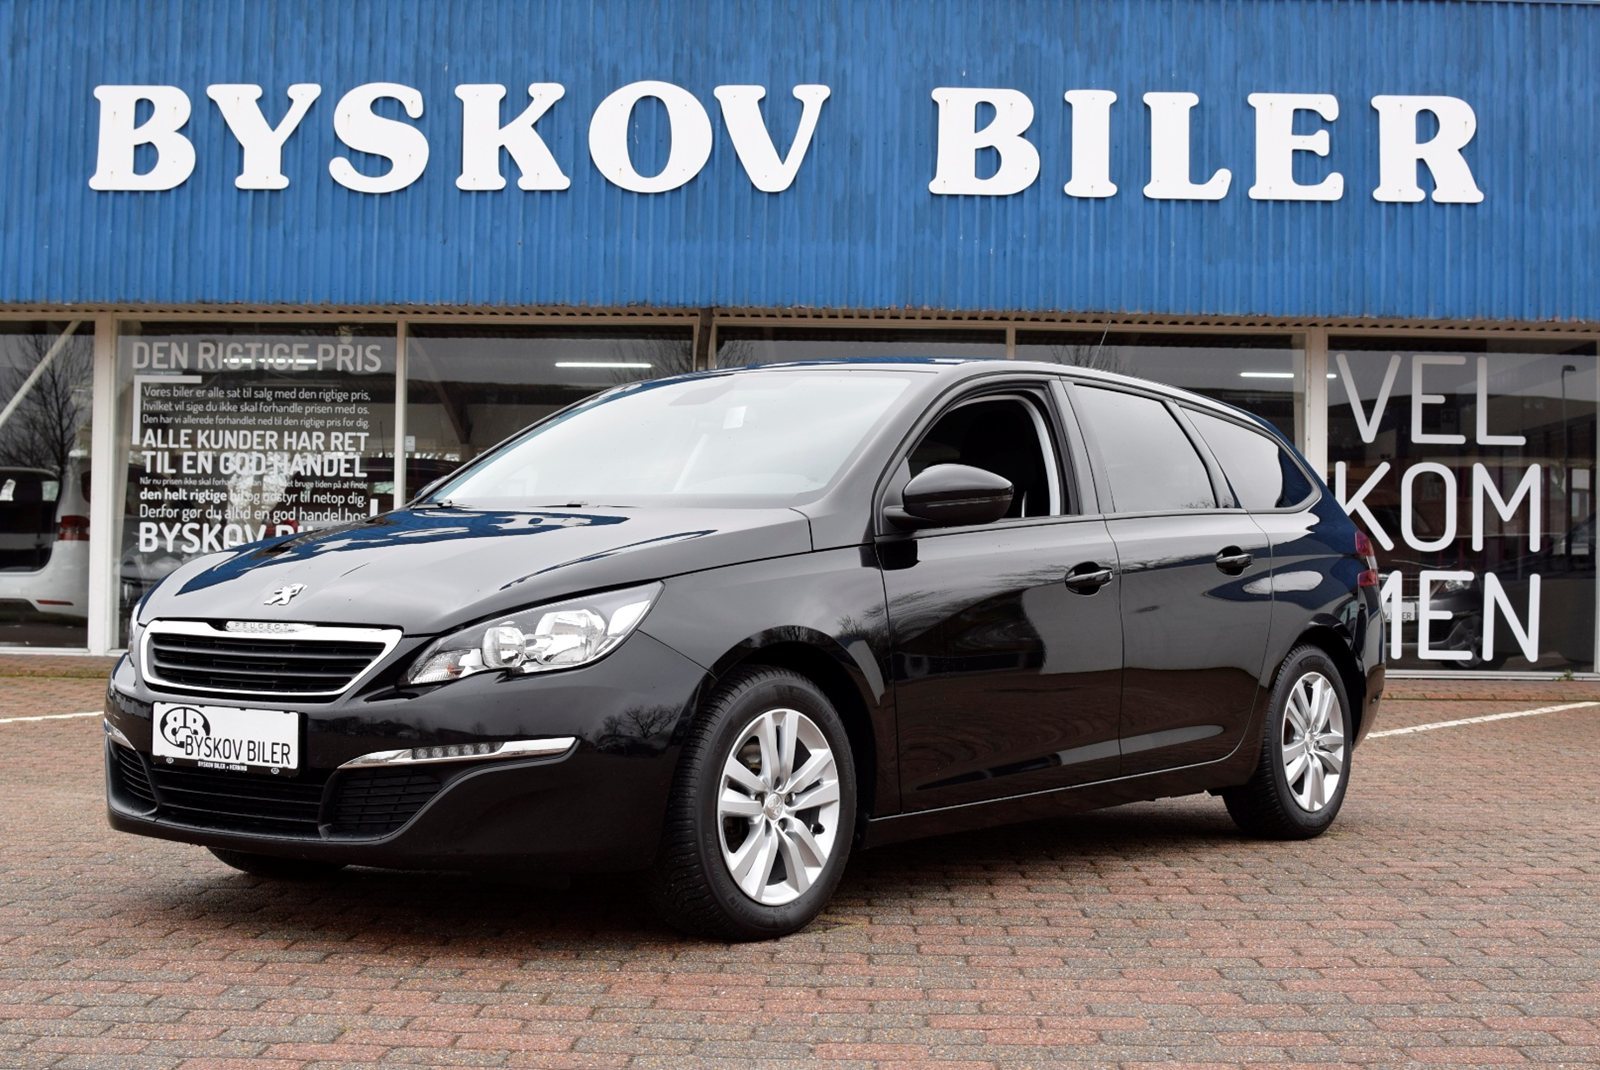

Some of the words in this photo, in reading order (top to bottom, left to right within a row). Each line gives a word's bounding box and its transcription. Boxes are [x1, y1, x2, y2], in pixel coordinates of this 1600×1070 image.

[88, 80, 832, 195] BYSKOV
[928, 86, 1485, 205] BILER
[132, 341, 188, 370] DEN
[197, 341, 310, 371] RIGTIGE
[317, 343, 382, 373] PRIS
[143, 386, 171, 397] Vores
[173, 386, 194, 397] biler
[195, 389, 205, 397] er
[207, 387, 225, 398] alle
[226, 388, 241, 398] sat
[243, 387, 252, 398] til
[253, 387, 273, 401] salg
[274, 388, 296, 399] med
[298, 388, 317, 399] den
[318, 389, 349, 402] rigtige
[350, 389, 371, 402] pris,
[1335, 353, 1527, 446] VEL
[142, 401, 173, 411] hvilket
[174, 401, 185, 411] vil
[186, 401, 204, 414] sige
[205, 401, 218, 412] du
[219, 402, 238, 412] ikke
[239, 402, 258, 412] skal
[259, 402, 303, 413] forhandle
[304, 403, 333, 415] prisen
[334, 404, 356, 414] med
[357, 406, 370, 415] os.
[142, 414, 159, 424] Den
[160, 414, 173, 424] har
[174, 415, 181, 424] vi
[182, 415, 214, 424] allerede
[215, 415, 256, 425] forhandlet
[257, 416, 273, 425] ned
[274, 416, 282, 425] til
[283, 417, 299, 426] den
[300, 417, 326, 428] rigtige
[326, 417, 342, 428] pris
[342, 418, 354, 427] for
[356, 418, 370, 429] dig.
[141, 428, 193, 448] ALLE
[197, 429, 279, 450] KUNDER
[283, 430, 325, 451] HAR
[330, 432, 370, 452] RET
[140, 451, 177, 474] TIL
[182, 451, 213, 475] EN
[219, 451, 266, 476] GOD
[272, 453, 368, 478] HANDEL
[162, 478, 182, 486] prisen
[294, 481, 314, 489] bruge
[315, 480, 333, 488] tiden
[350, 481, 367, 489] finde
[140, 488, 161, 500] den
[164, 488, 187, 500] helt
[190, 489, 227, 504] rigtige
[247, 493, 260, 505] og
[300, 491, 310, 503] til
[313, 492, 345, 507] netop
[347, 492, 367, 508] dig.
[1335, 461, 1542, 553] KOM
[140, 504, 179, 518] Derfor
[182, 508, 202, 522] gør
[205, 505, 219, 518] du
[224, 506, 251, 519] altid
[254, 510, 270, 520] en
[273, 507, 296, 524] god
[299, 507, 341, 522] handel
[344, 508, 367, 522] hos
[139, 522, 266, 554] BYSKOV
[234, 622, 290, 630] PEUGEOT
[184, 734, 243, 761] BYSKOV
[247, 740, 291, 765] BILER
